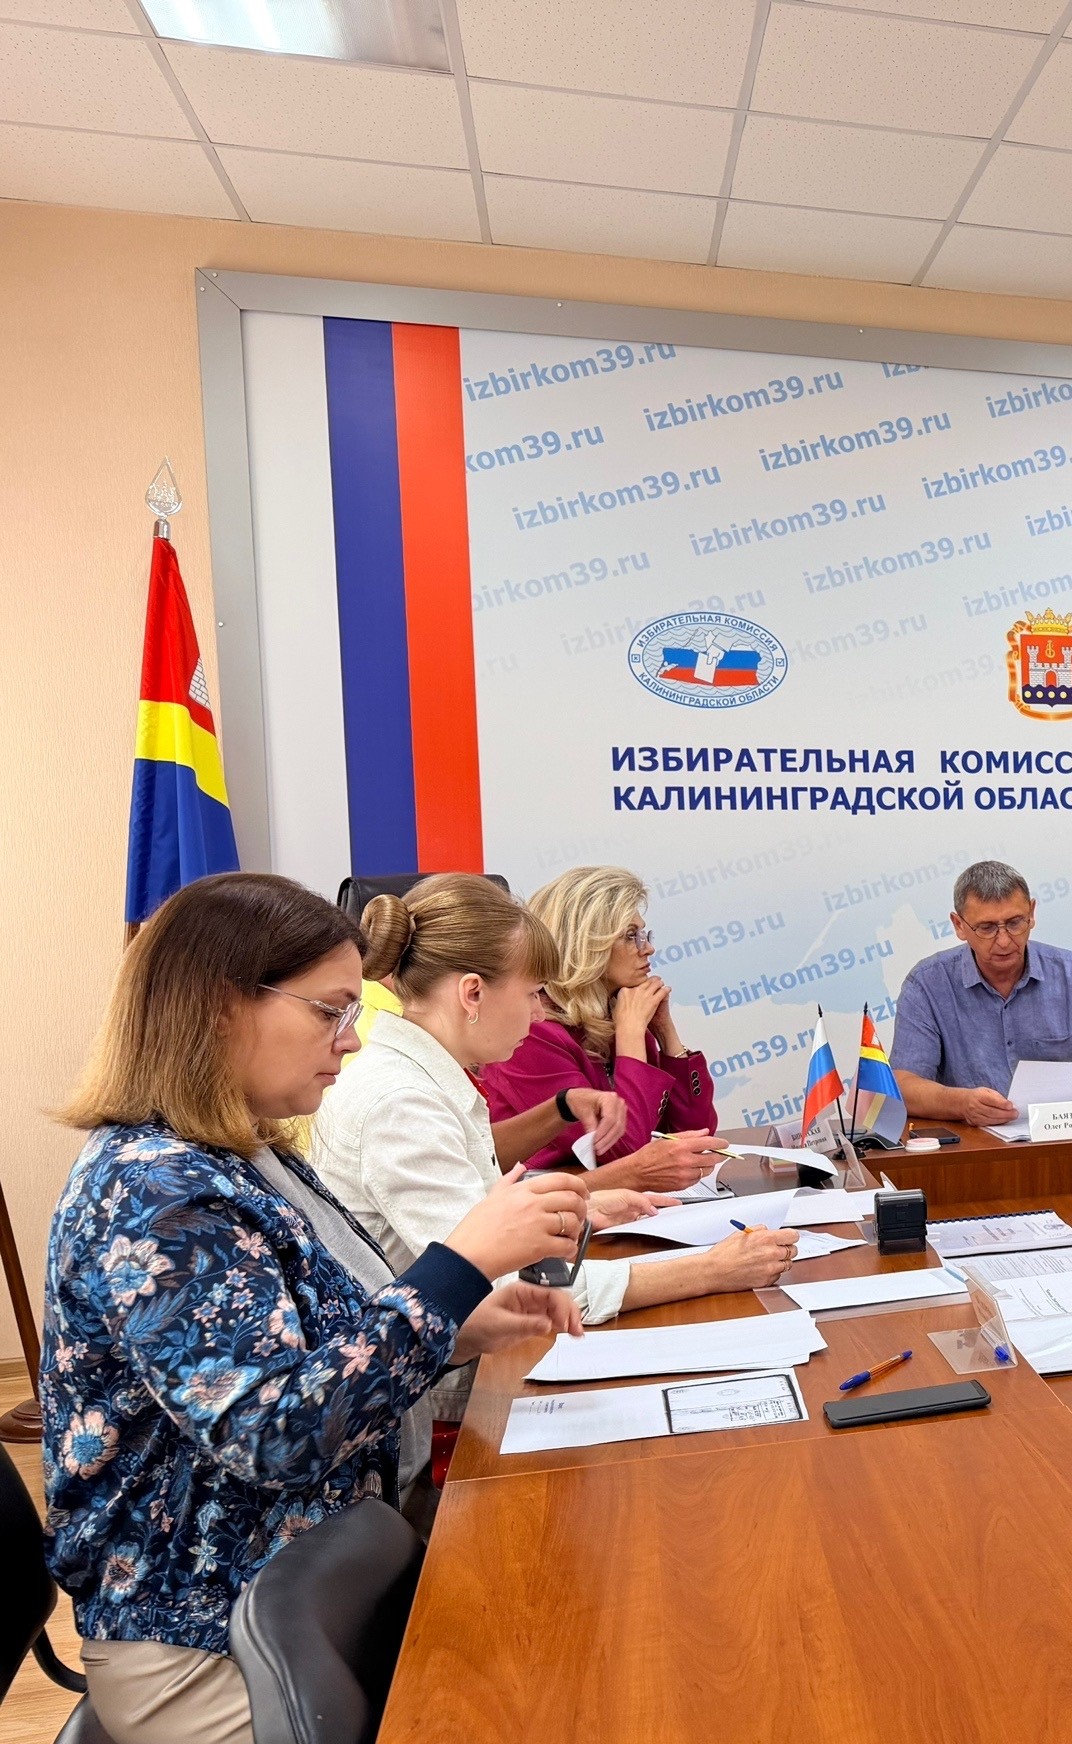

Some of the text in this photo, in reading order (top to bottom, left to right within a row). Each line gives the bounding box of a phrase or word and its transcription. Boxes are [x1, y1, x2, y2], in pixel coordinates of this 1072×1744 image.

[463, 343, 676, 402] izbirkom39.ru
[643, 370, 843, 431] izbirkom39.ru
[759, 410, 951, 471] izbirkom39.ru
[512, 465, 721, 531] izbirkom39.ru
[689, 491, 886, 556] izbirkom39.ru
[803, 530, 991, 594] izbirkom39.ru
[636, 614, 778, 652] ИЗБИРАТЕЛЬНАЯ КОМИССИЯ
[638, 672, 779, 707] КАЛИНИНГРАДСКОЙ ОБЛАСТИ
[611, 747, 915, 774] ИЗБИРАТЕЛЬНАЯ
[613, 780, 964, 814] КАЛИНИНГРАДСКОЙ
[698, 937, 894, 1016] izbirkom39.ru
